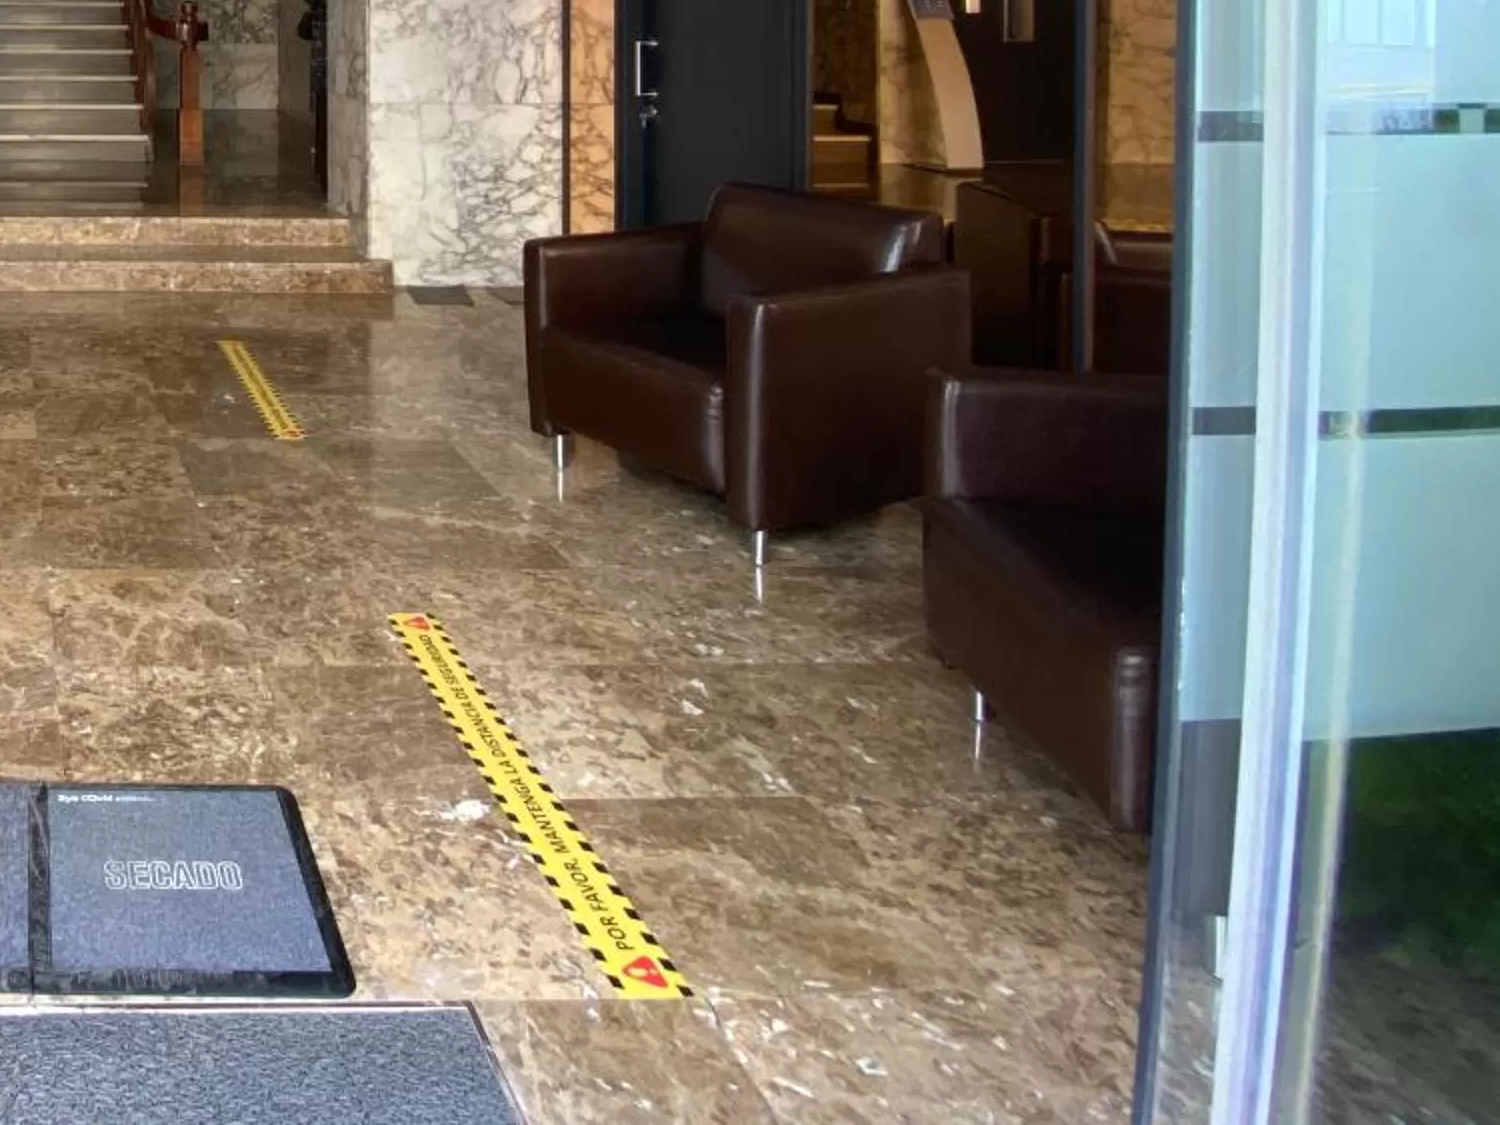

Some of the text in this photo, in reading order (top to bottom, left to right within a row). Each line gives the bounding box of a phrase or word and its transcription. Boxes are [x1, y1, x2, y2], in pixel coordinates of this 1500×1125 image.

[461, 701, 506, 758] DISTANCIA
[498, 760, 518, 774] LA
[510, 777, 570, 854] MANTENGA
[104, 860, 244, 890] SECADO
[600, 916, 635, 950] POR
